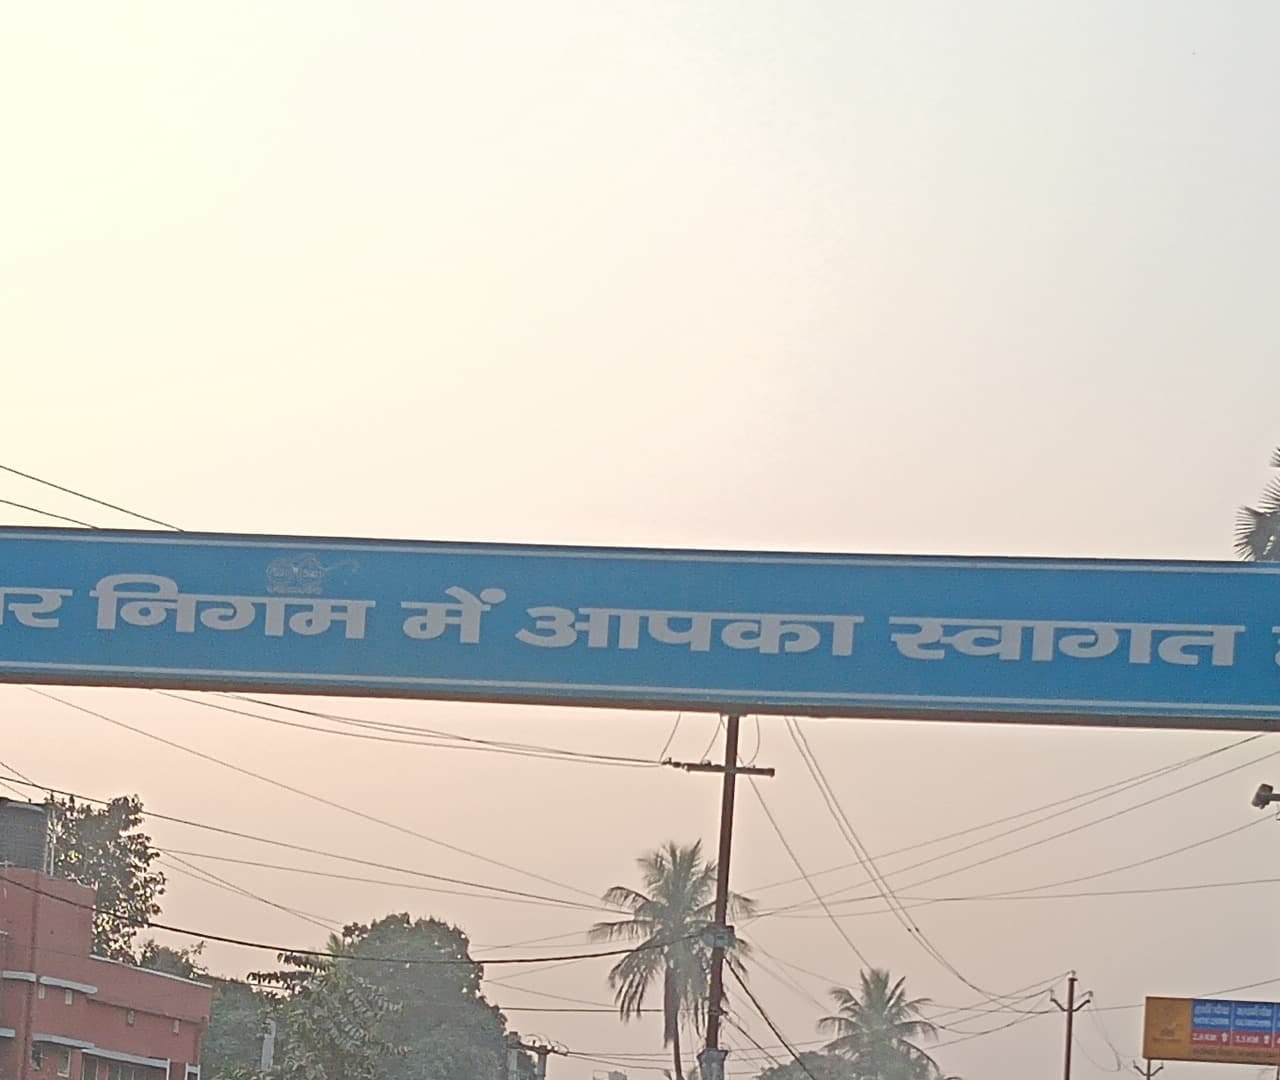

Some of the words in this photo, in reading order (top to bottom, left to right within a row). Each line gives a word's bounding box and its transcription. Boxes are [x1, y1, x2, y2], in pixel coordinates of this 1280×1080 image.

[89, 573, 376, 640] निगम
[401, 585, 506, 644] में
[515, 606, 865, 657] आपका
[888, 616, 1246, 666] स्वागत
